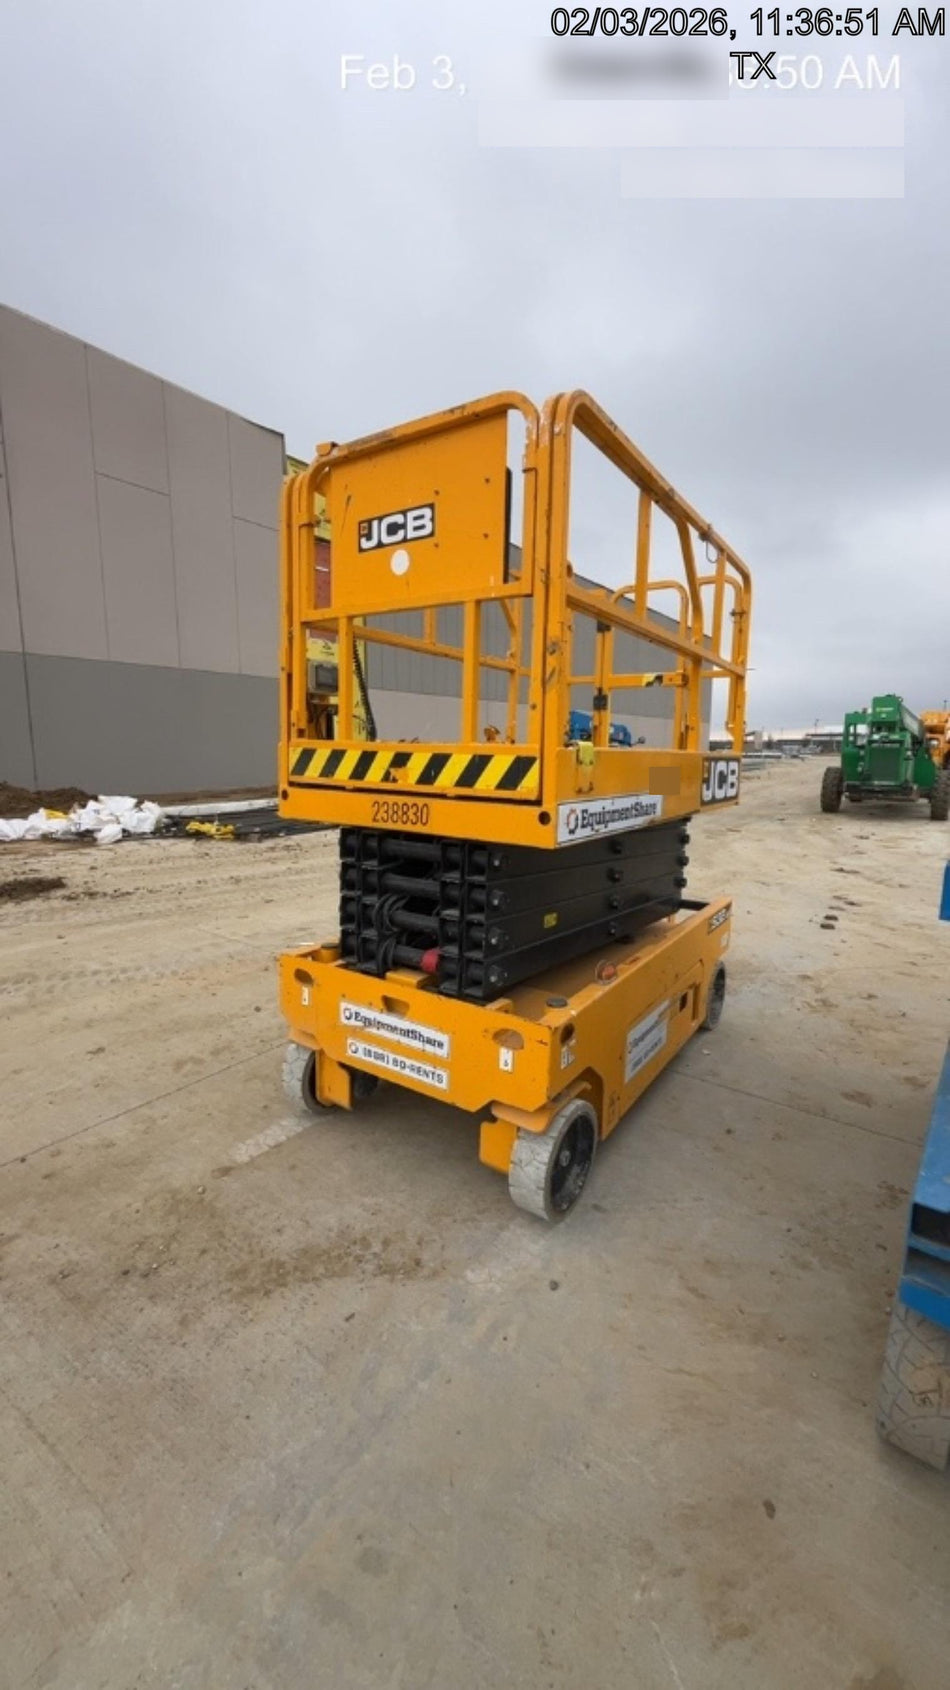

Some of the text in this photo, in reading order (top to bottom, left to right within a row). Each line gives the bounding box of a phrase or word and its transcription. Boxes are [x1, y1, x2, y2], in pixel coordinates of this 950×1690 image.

[360, 506, 433, 550] JCB
[702, 760, 739, 802] JCB
[371, 800, 429, 827] 238830
[580, 801, 658, 832] EquipmentShare
[354, 1011, 445, 1050] EquipmentShare
